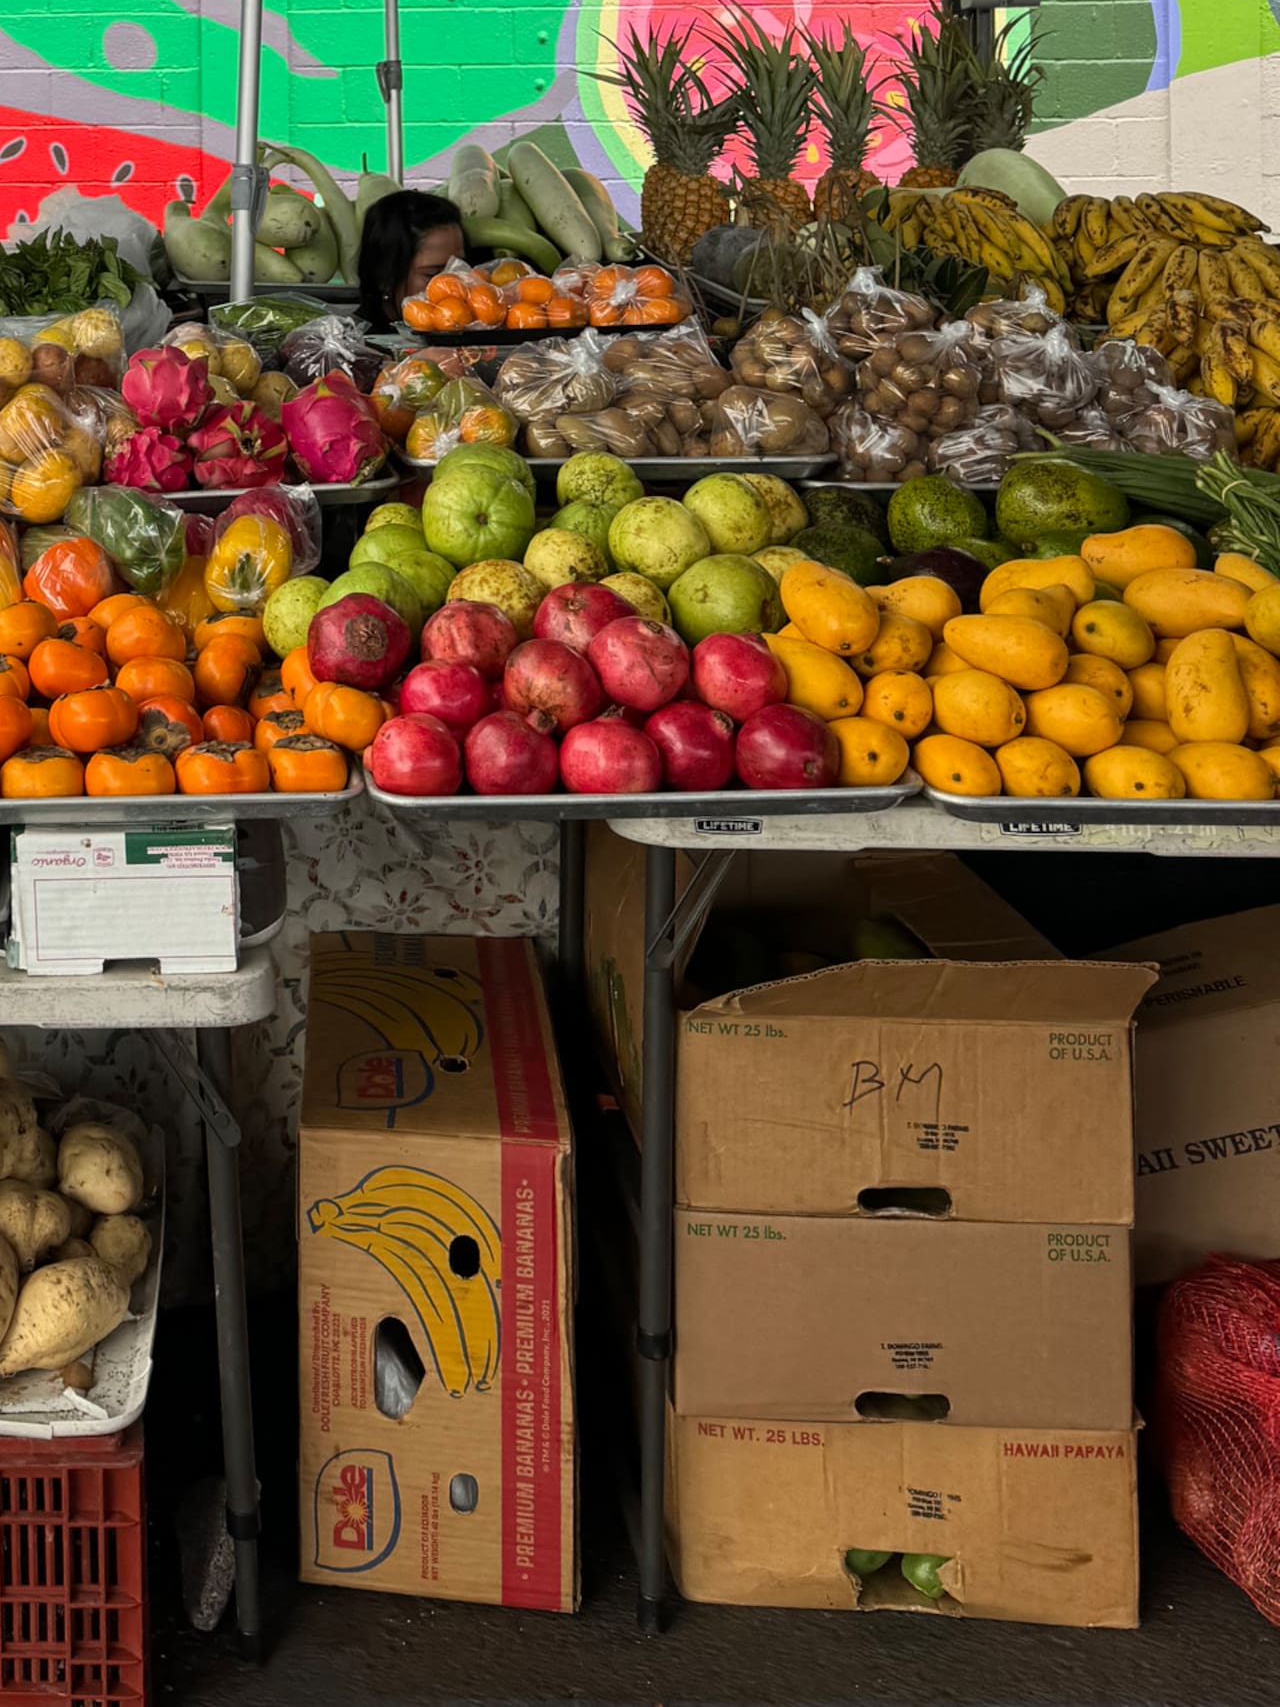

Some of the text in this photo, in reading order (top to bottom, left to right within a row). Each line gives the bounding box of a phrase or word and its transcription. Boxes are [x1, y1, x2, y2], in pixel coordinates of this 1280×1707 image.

[703, 821, 754, 832] LIFETIME
[1009, 823, 1073, 832] LIFETIME
[31, 854, 87, 869] Organic
[688, 1020, 788, 1038] NET WT 25 lbs.
[1049, 1032, 1112, 1047] PRODUCT
[1049, 1047, 1112, 1061] OF U.S.A.
[356, 1057, 395, 1100] Dole
[687, 1224, 786, 1240] NET WT 25 lbs.
[1048, 1233, 1110, 1248] PRODUCT
[1048, 1248, 1111, 1263] OF U.S.A.
[542, 1300, 552, 1322] 2021
[320, 1283, 331, 1433] DOLE FRESH FRUIT COMPANY
[515, 1188, 535, 1568] PREMIUM BANANAS PREMIUM BANANAS
[542, 1388, 552, 1410] Food
[542, 1411, 552, 1431] Dole
[698, 1422, 825, 1446] NET WT. 25 LBS.
[1004, 1443, 1124, 1458] HAWAII PAPAYA
[333, 1465, 367, 1551] Dole
